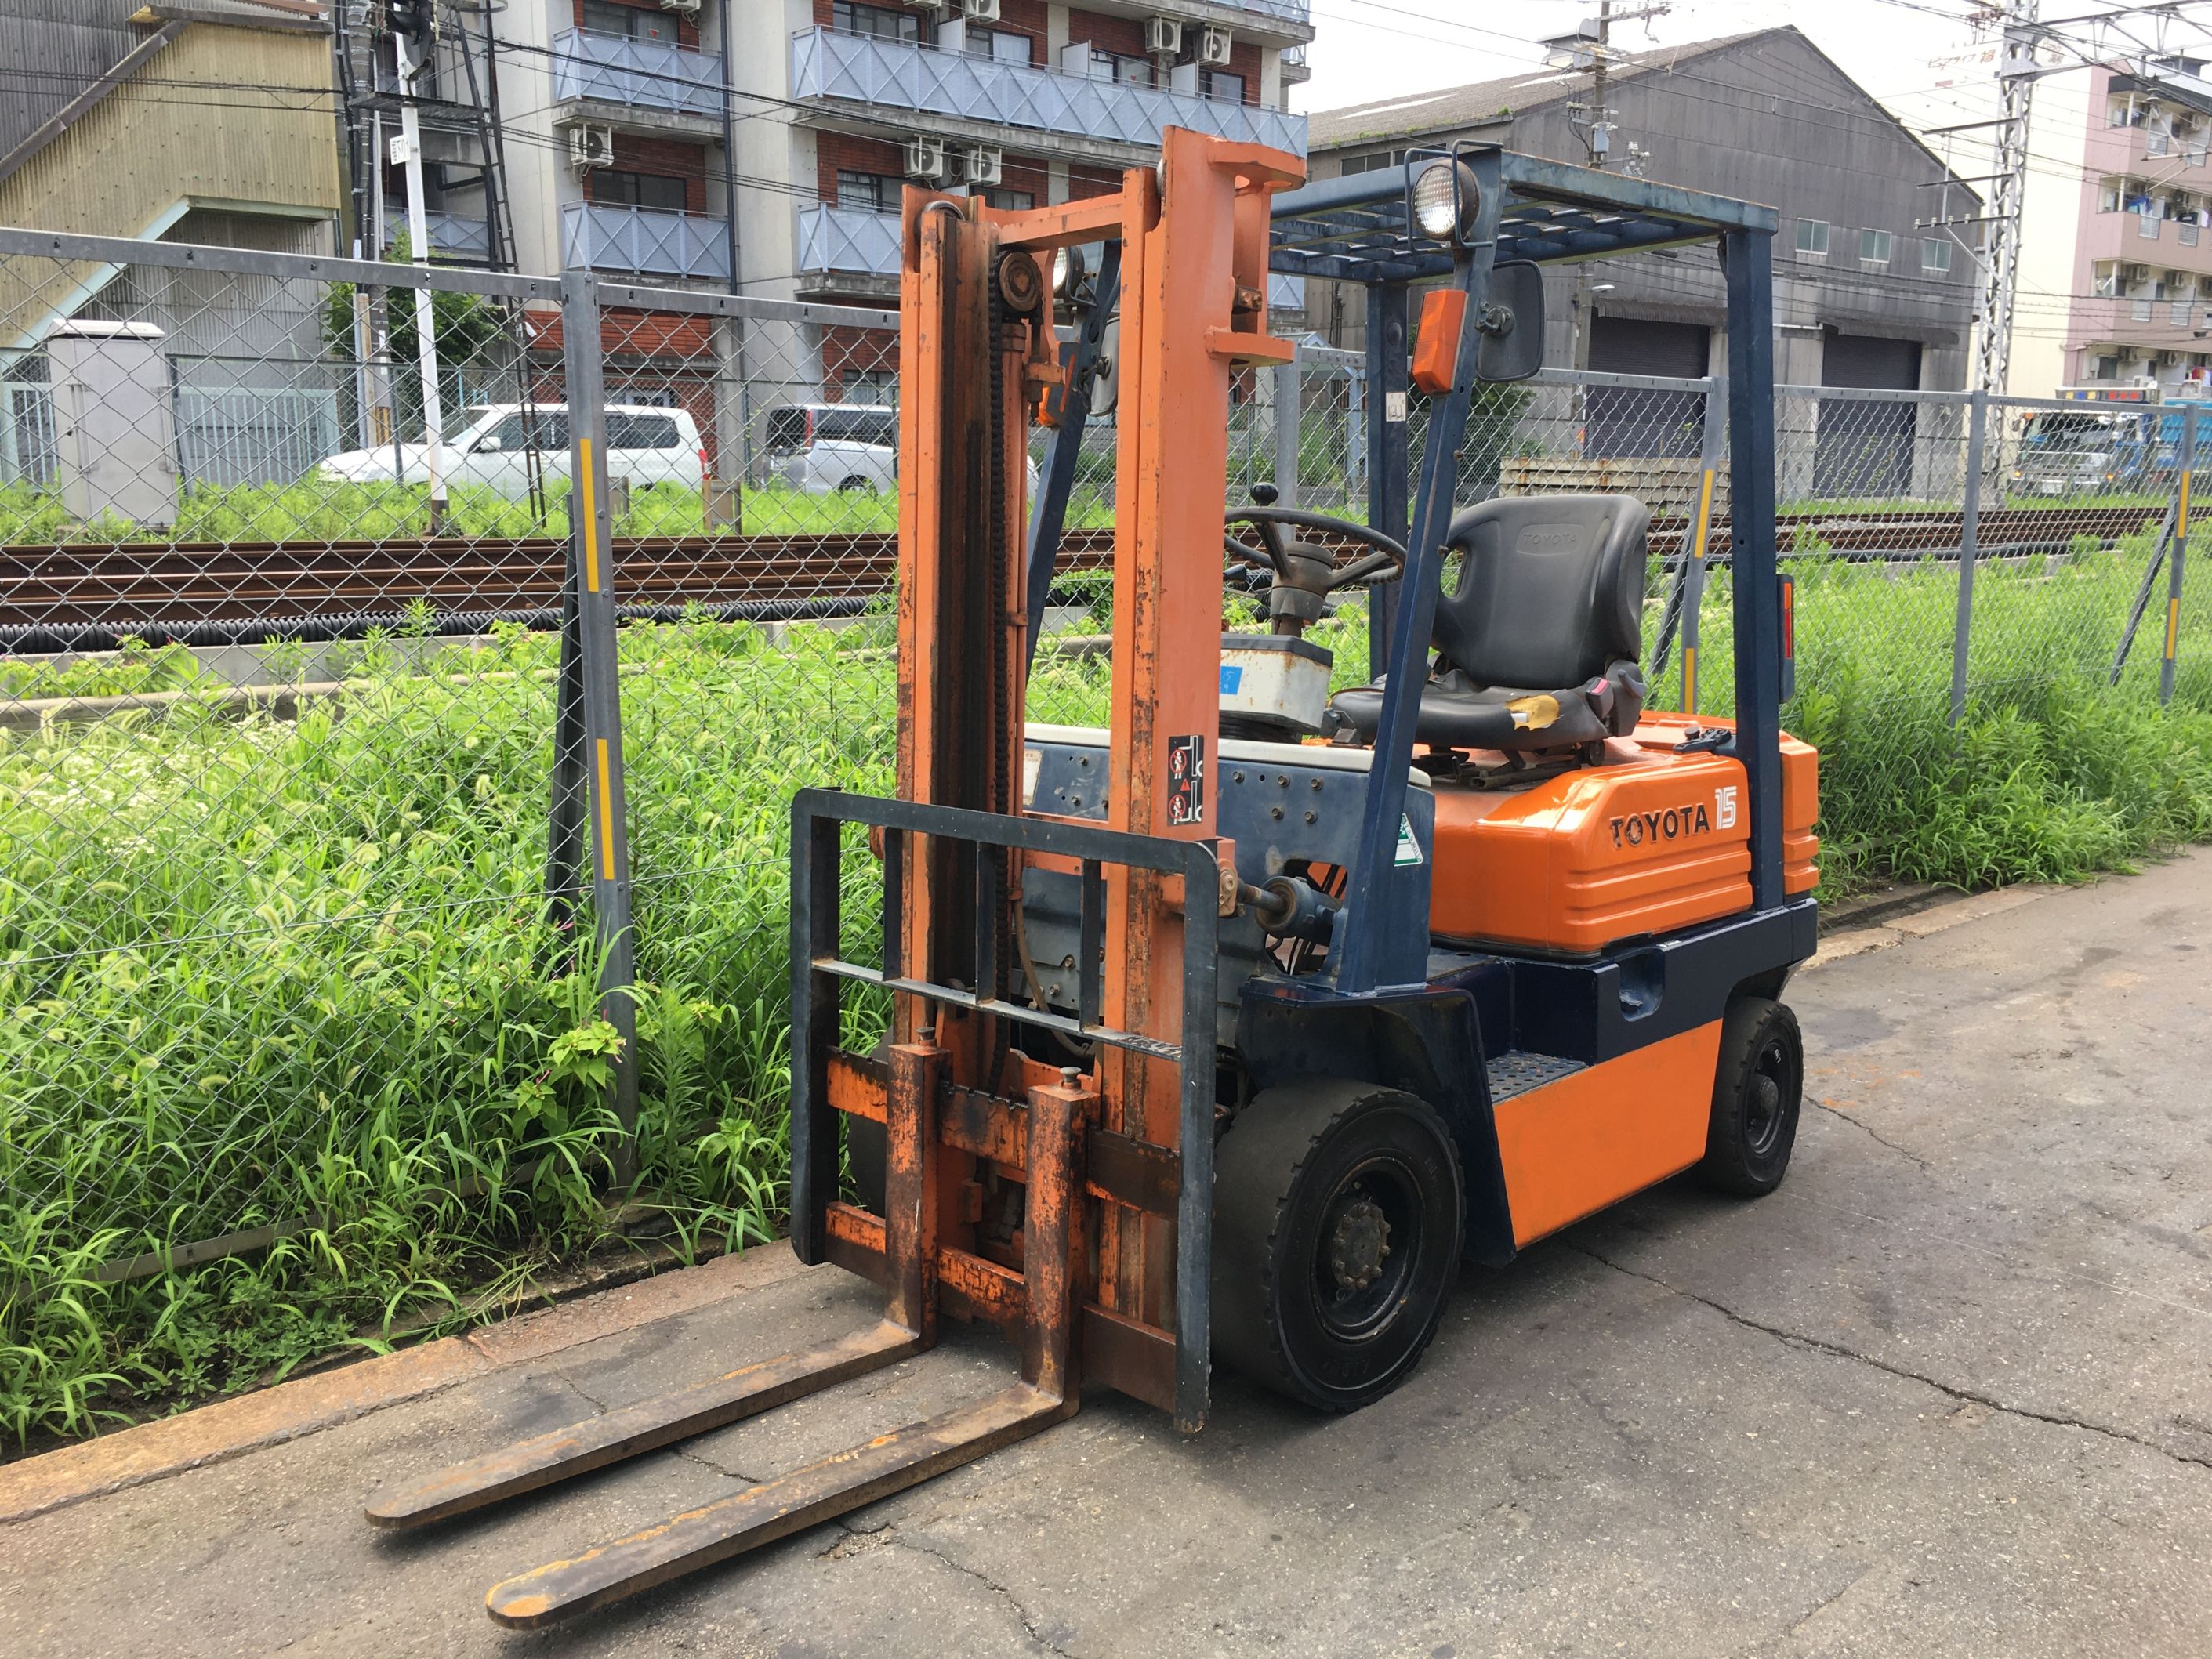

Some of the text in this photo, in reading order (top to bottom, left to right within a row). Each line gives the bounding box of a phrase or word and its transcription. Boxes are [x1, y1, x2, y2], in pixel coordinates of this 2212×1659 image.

[1523, 533, 1578, 546] TOYOTA
[1610, 786, 1737, 849] TOYOTA 15
